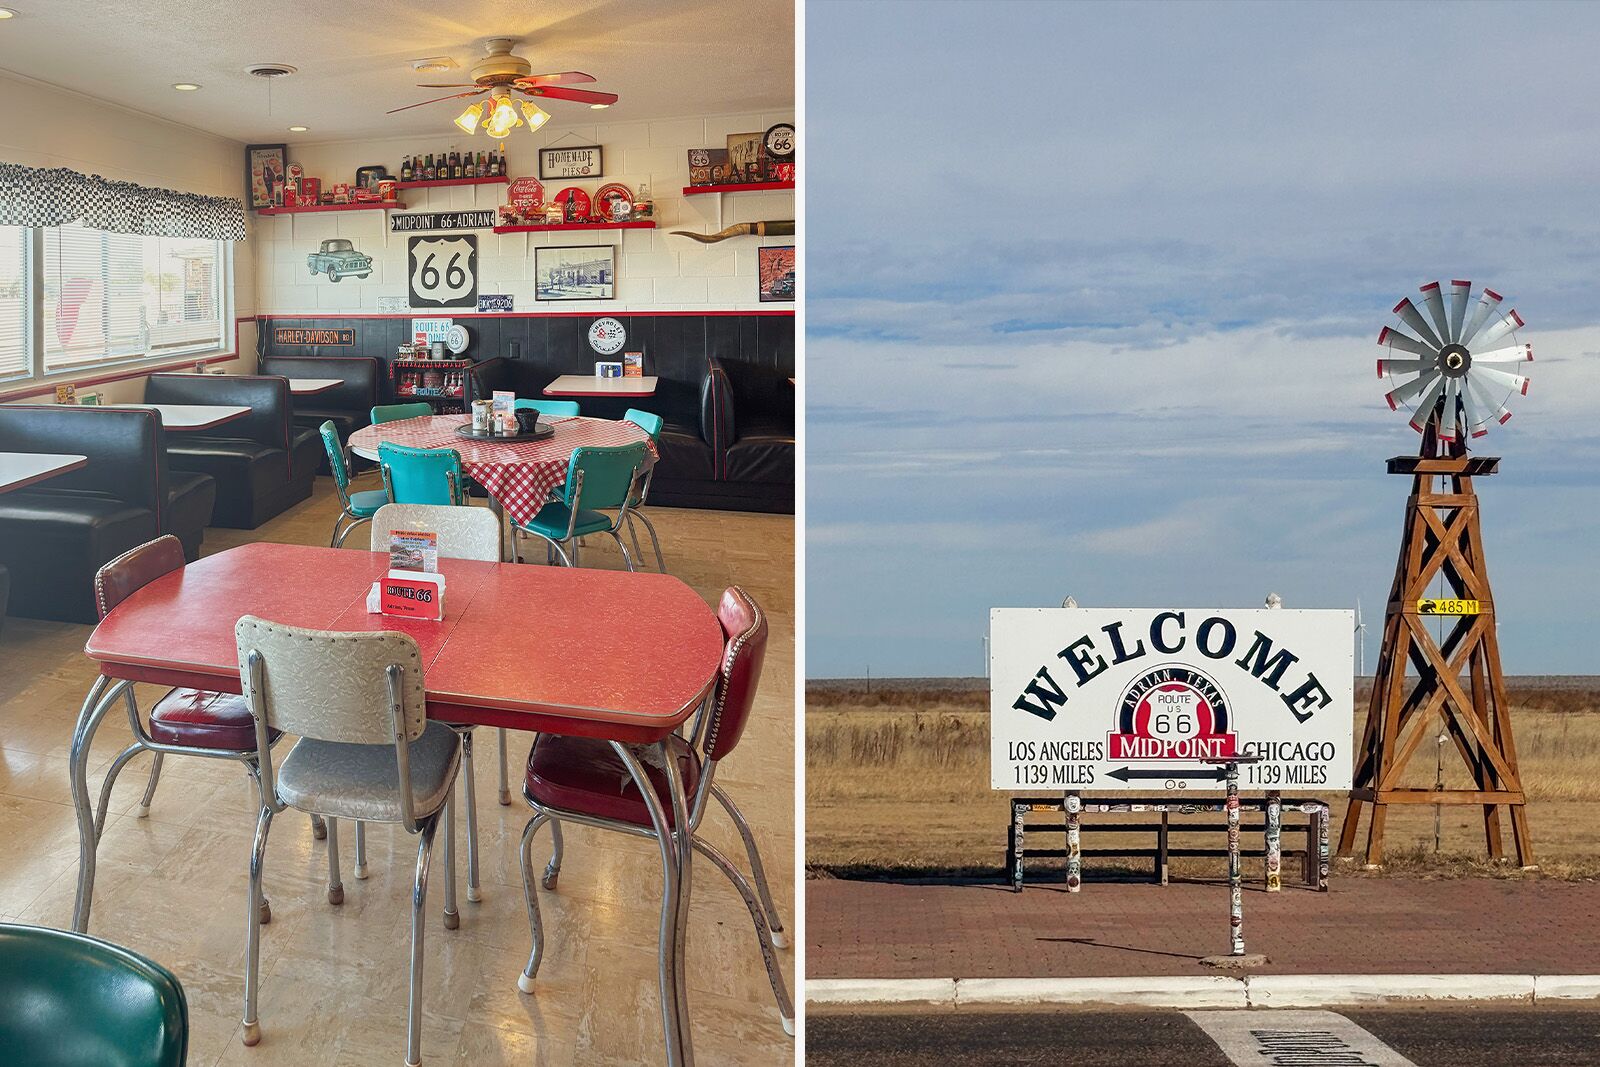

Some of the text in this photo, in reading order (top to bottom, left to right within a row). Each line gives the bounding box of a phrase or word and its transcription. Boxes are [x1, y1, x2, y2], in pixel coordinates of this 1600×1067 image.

[774, 138, 792, 150] 66
[548, 150, 594, 169] HOMEMADE
[562, 166, 581, 177] PIES
[513, 198, 539, 207] STOPS
[396, 213, 490, 230] MIDPOINT 66-ADRIAN
[420, 252, 466, 290] 66
[415, 322, 450, 332] ROUTE 66
[592, 320, 623, 334] CHEVROLET
[278, 330, 339, 343] HARLEY-DAVIDSON
[387, 585, 432, 603] ROUTE 66
[1439, 601, 1477, 613] 485 M
[1011, 611, 1333, 724] WELCOME
[1186, 671, 1224, 708] TEXAS
[1158, 694, 1191, 704] ROUTE
[1156, 714, 1191, 734] 66
[1009, 741, 1103, 761] LOS ANGELES
[1119, 736, 1225, 758] MIDPOINT
[1243, 741, 1335, 762] CHICAGO
[1014, 765, 1094, 784] 1139 MILES
[1247, 765, 1327, 784] 1139 MILES
